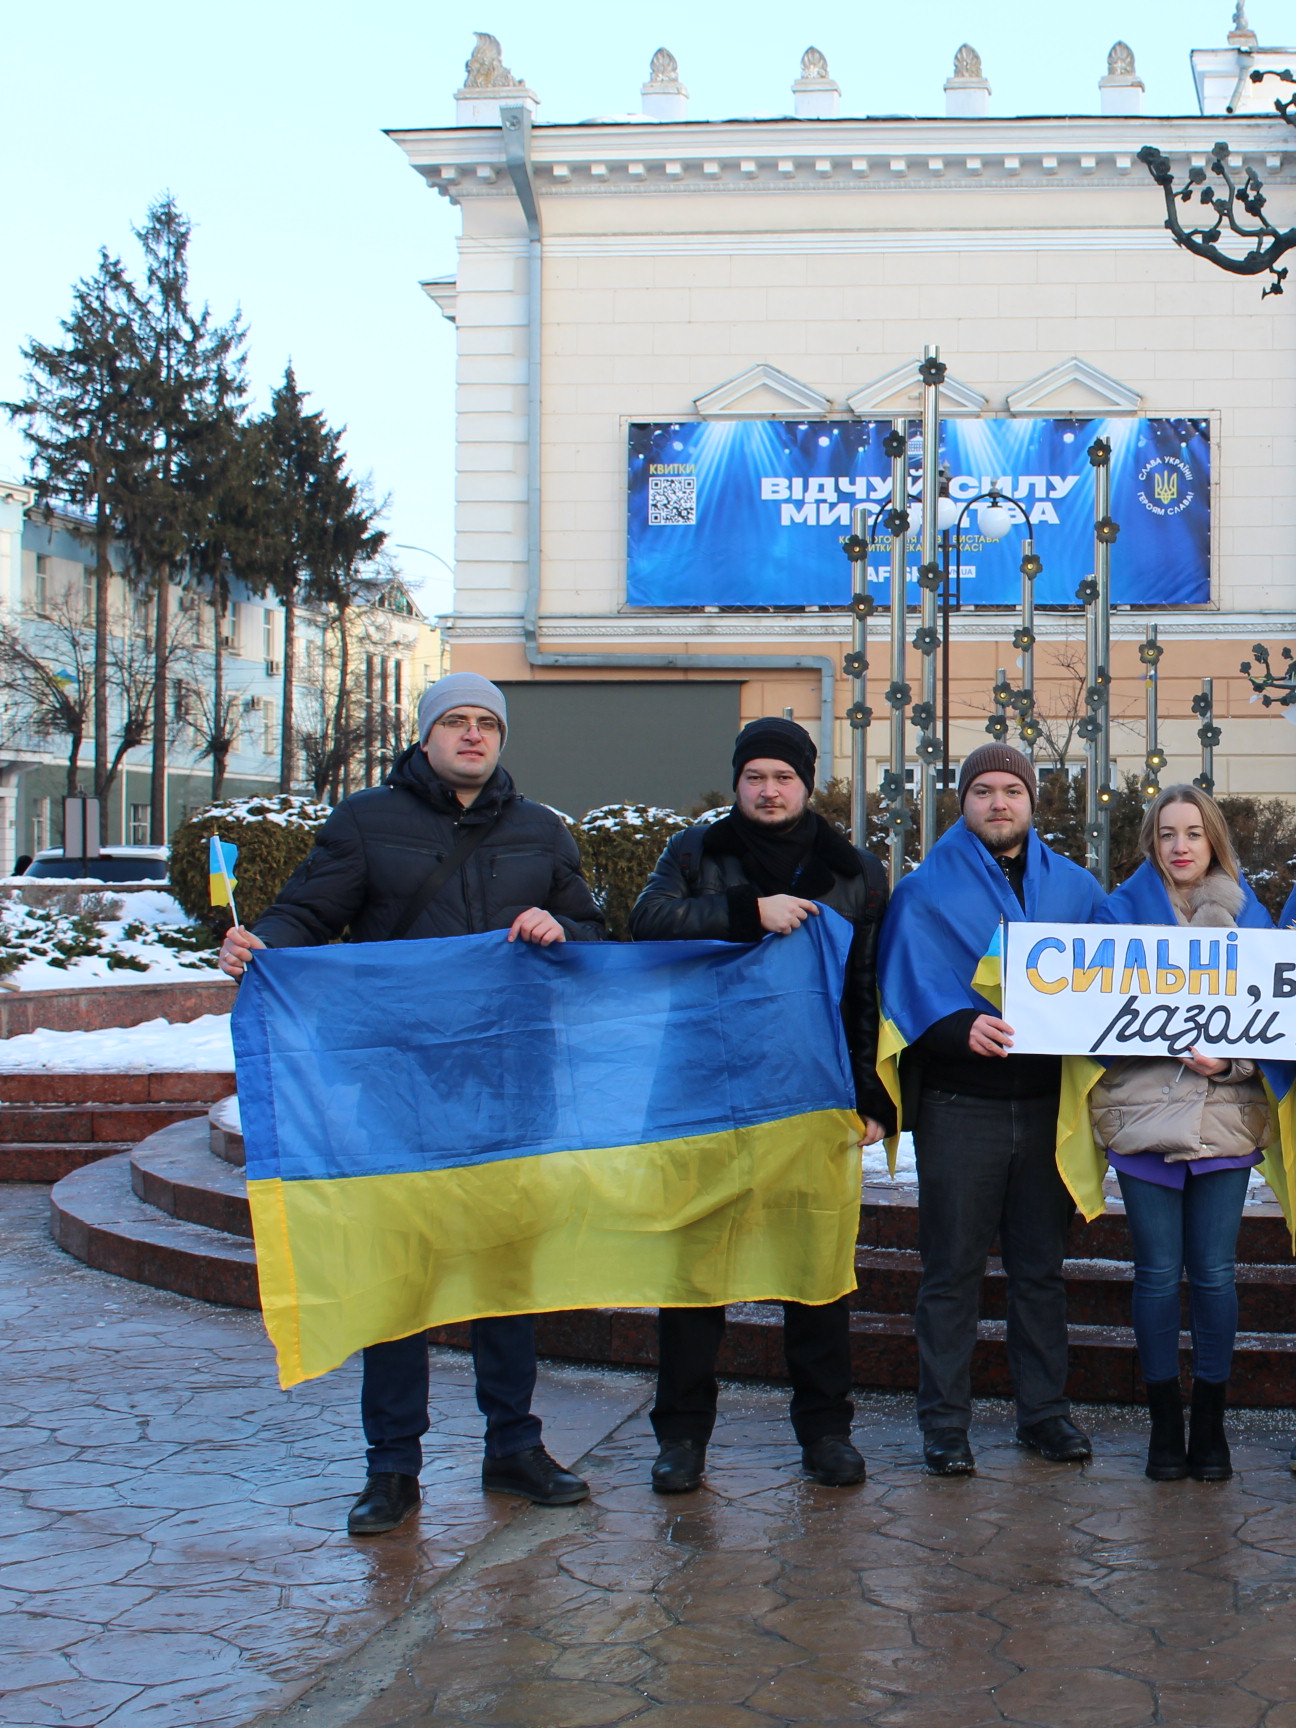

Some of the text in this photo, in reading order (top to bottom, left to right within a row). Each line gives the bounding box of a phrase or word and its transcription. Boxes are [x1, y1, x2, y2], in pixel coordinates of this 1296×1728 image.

[649, 463, 696, 475] КВИТКИ
[1138, 457, 1162, 480] СЛАВА
[949, 475, 1080, 499] СИЛУ
[1137, 491, 1195, 516] ГЕРОЯМ СЛАВА!
